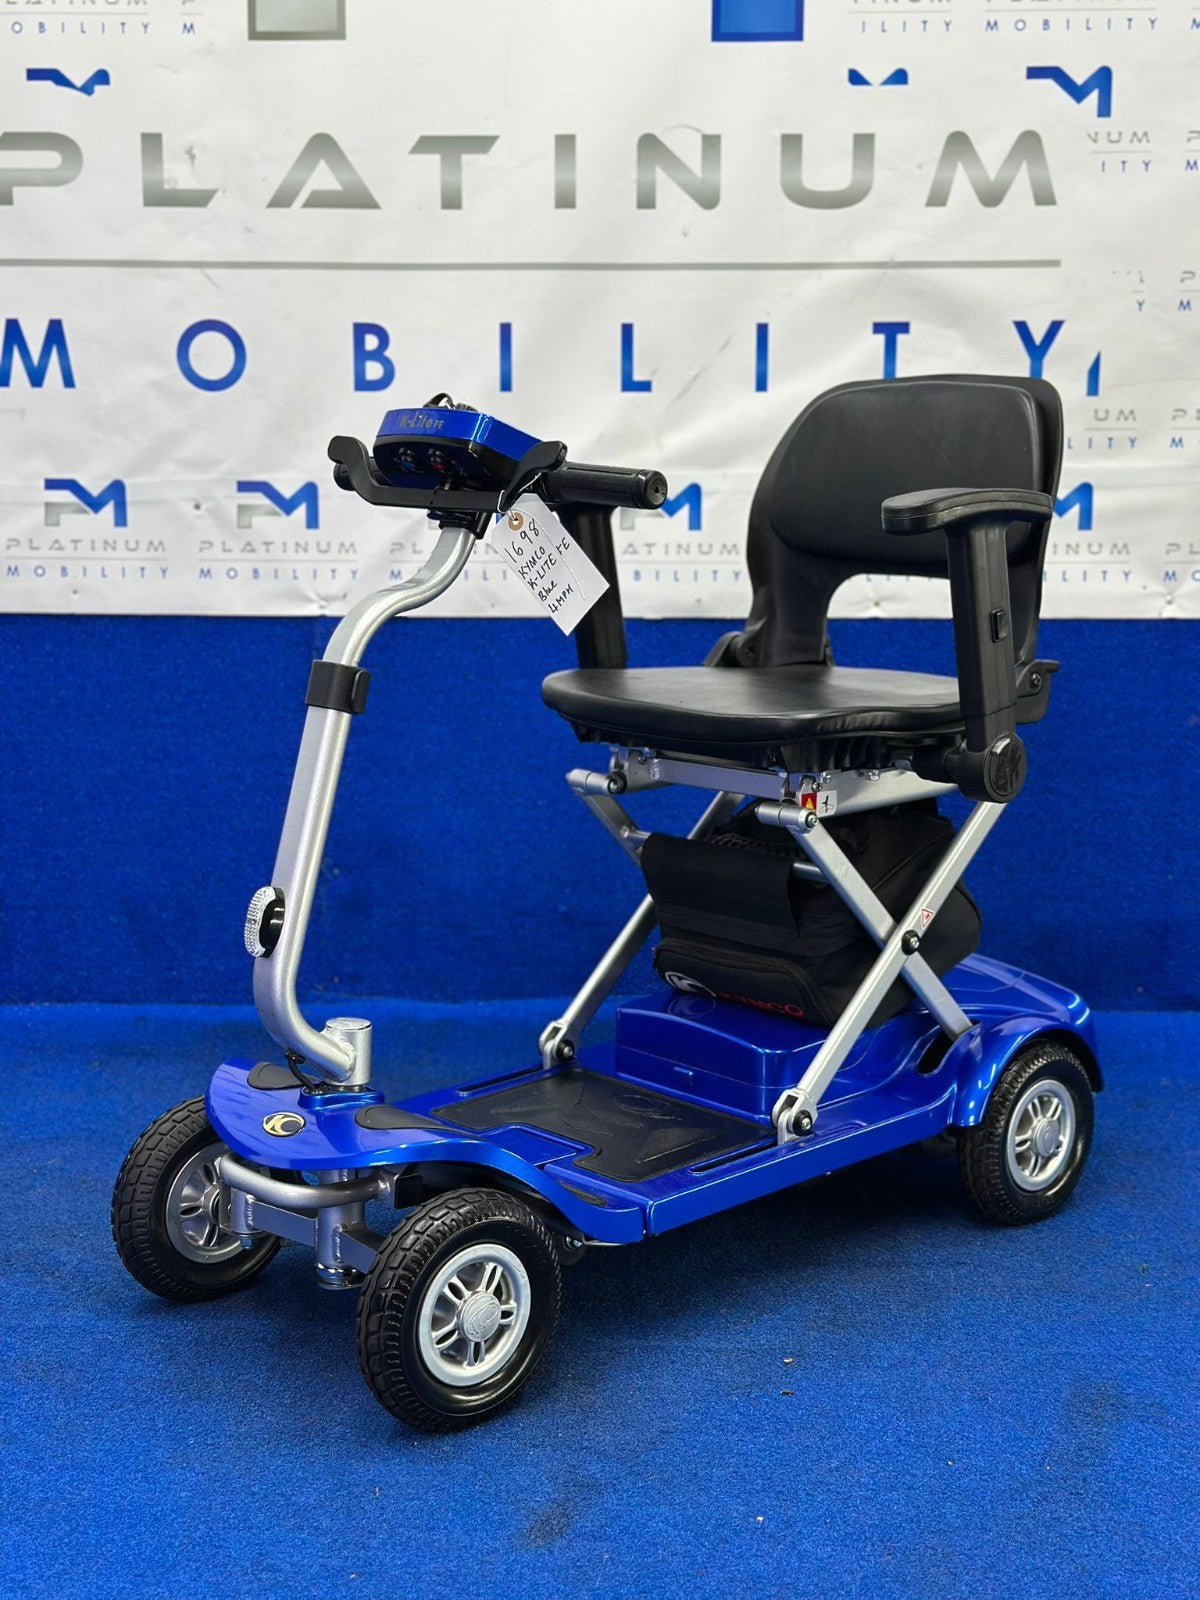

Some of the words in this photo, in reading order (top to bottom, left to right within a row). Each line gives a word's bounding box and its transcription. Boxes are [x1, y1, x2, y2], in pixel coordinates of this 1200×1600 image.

[11, 21, 150, 34] OBILITY
[861, 20, 952, 33] ILITY
[985, 17, 1157, 32] MOBILITY
[0, 130, 1057, 210] PLATINUM
[0, 318, 1065, 393] MOBILITY
[1066, 436, 1138, 449] LITY
[6, 537, 167, 552] PLATINUM
[199, 540, 358, 555] PLATINUM
[504, 517, 540, 564] 1698
[622, 542, 741, 555] ATINUM
[1052, 542, 1130, 555] INUM
[518, 545, 546, 580] KYMCO
[6, 565, 169, 579] MOBILITY
[198, 567, 359, 581] MOBILITY
[527, 552, 557, 591] K-LITE
[633, 569, 742, 583] BILITY
[1042, 569, 1132, 582] ILITY
[537, 580, 558, 602] Blue
[547, 584, 575, 614] 4MPH
